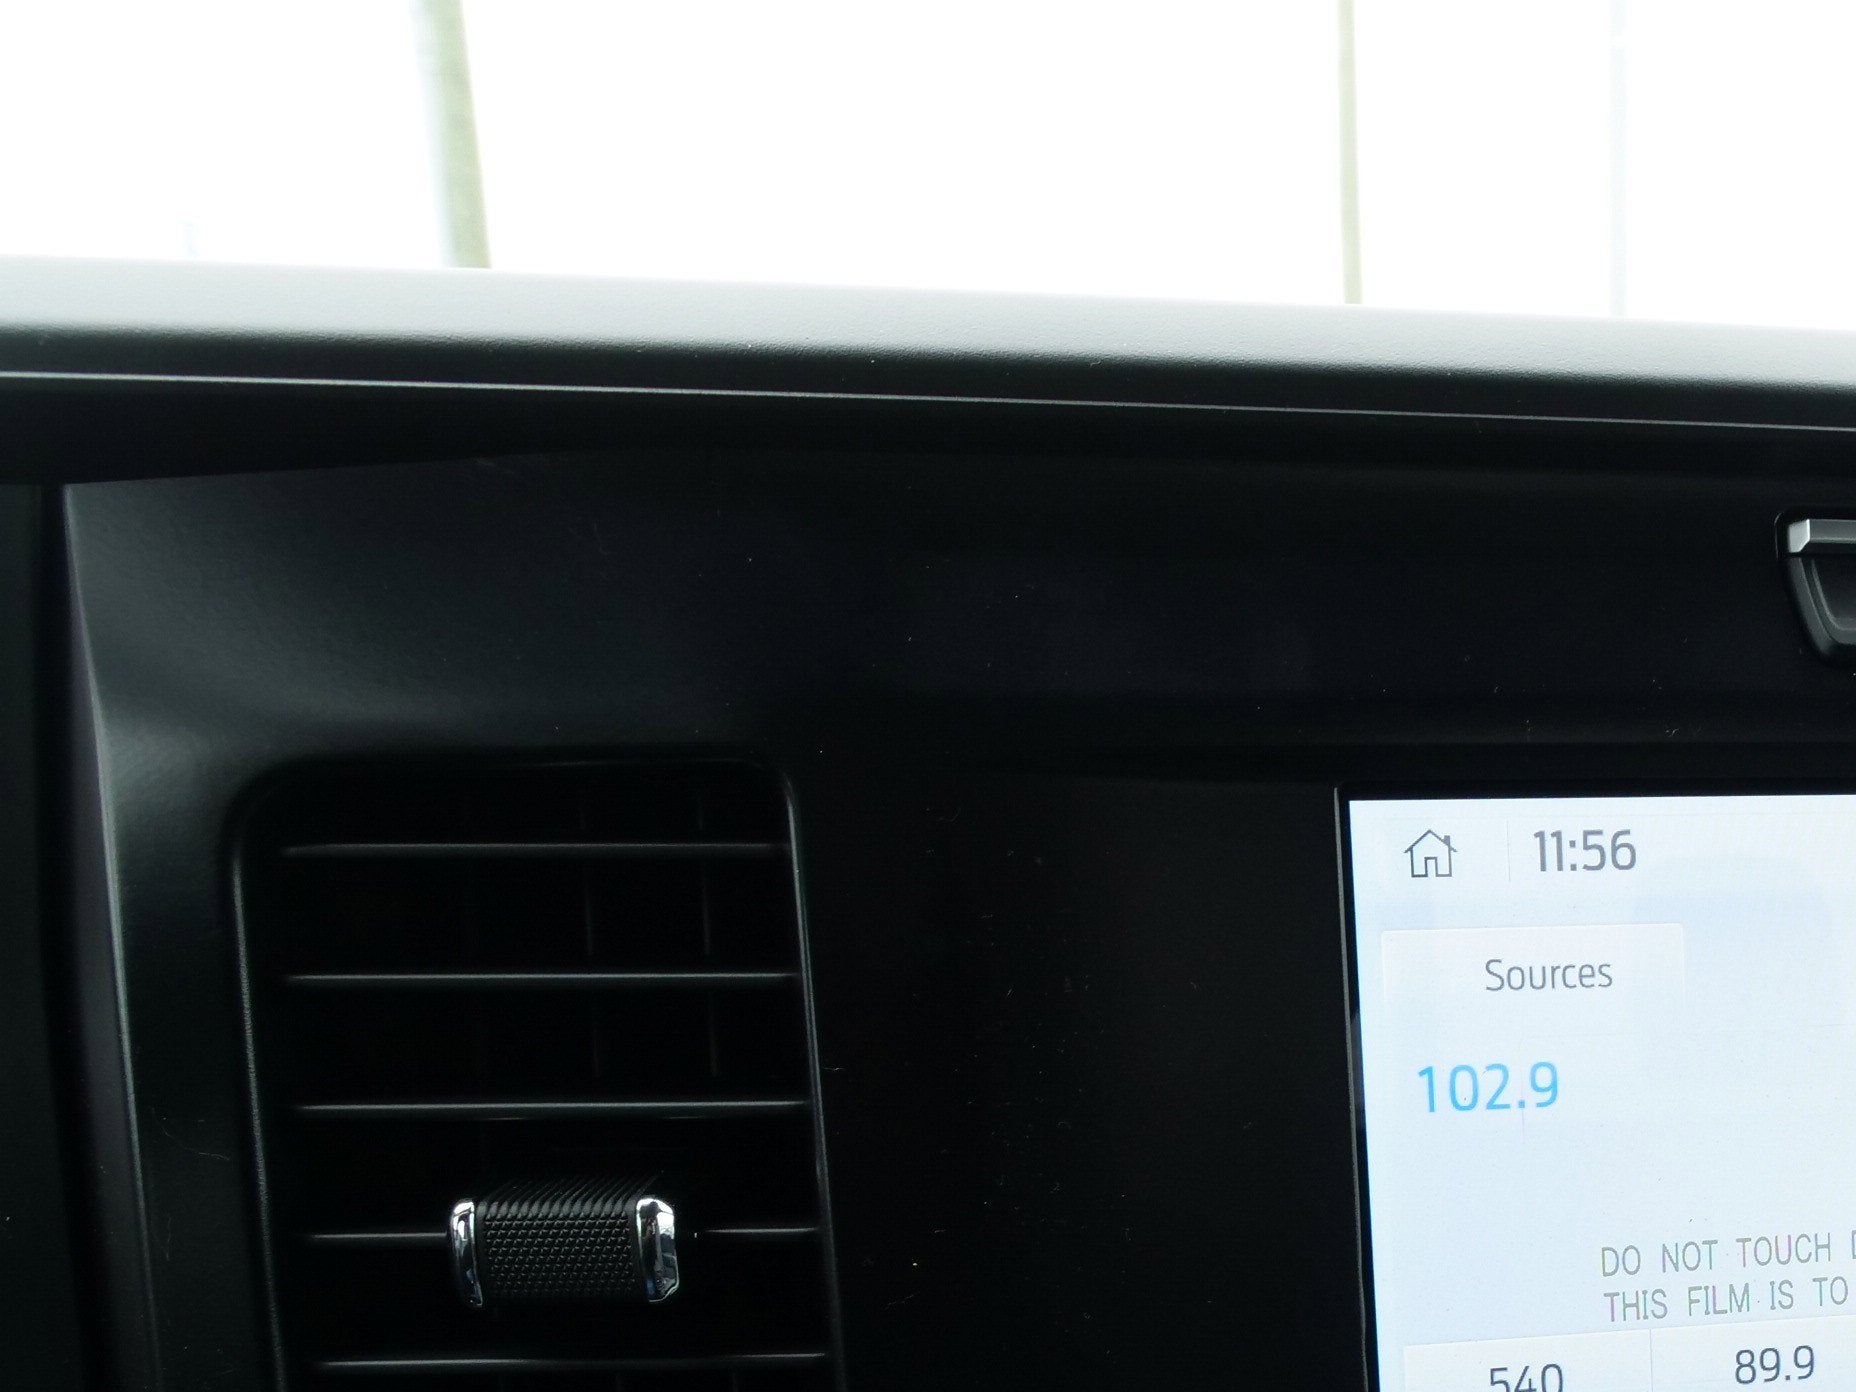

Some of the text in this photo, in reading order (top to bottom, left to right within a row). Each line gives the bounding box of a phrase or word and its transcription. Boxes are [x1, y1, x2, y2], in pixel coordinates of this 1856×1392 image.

[1533, 829, 1637, 873] 11:56
[1484, 958, 1613, 992] Sources
[1417, 1061, 1559, 1113] 102.9
[1601, 1245, 1642, 1278] DO
[1661, 1240, 1719, 1274] NOT
[1736, 1233, 1832, 1268] TOUCH
[1603, 1289, 1668, 1323] THIS
[1687, 1283, 1751, 1317] FILM
[1769, 1280, 1794, 1311] IS
[1811, 1276, 1849, 1307] TO
[1734, 1344, 1815, 1385] 89.9
